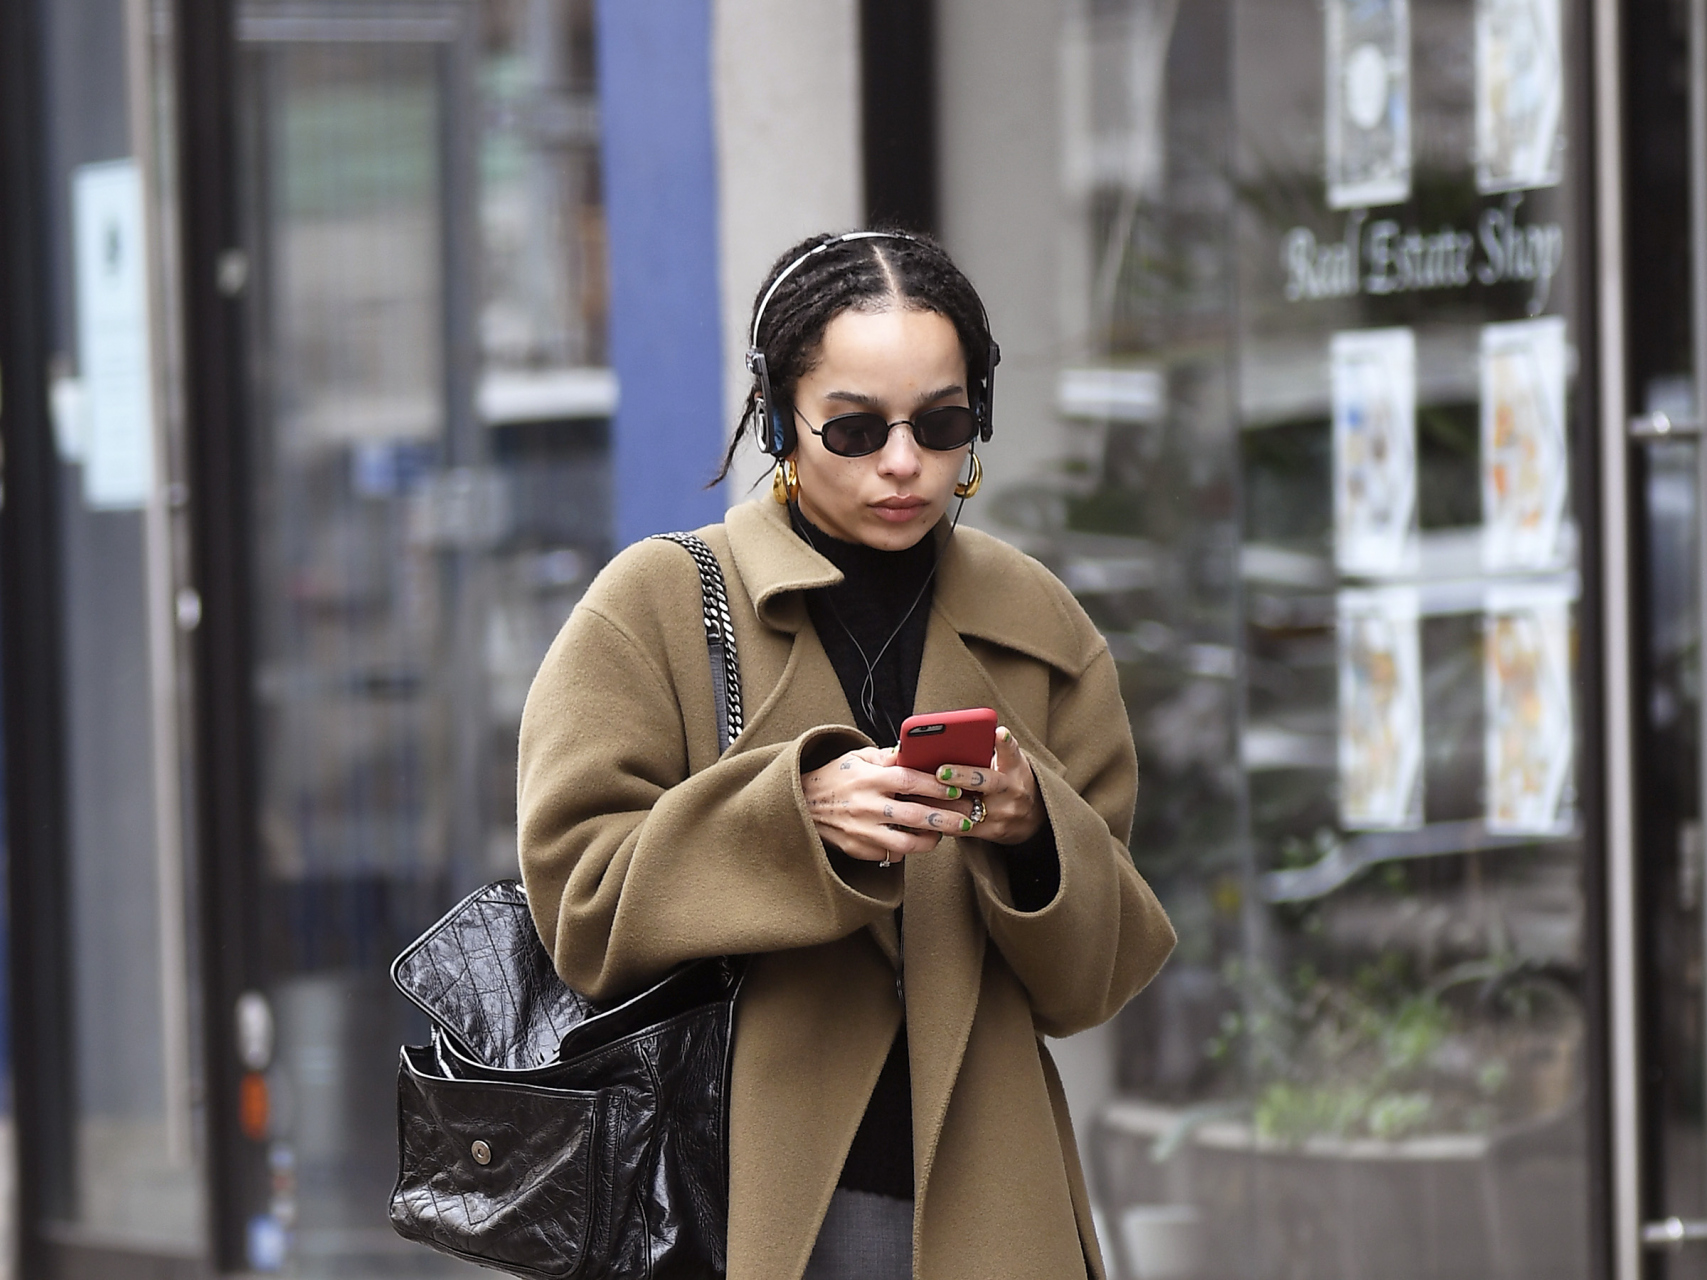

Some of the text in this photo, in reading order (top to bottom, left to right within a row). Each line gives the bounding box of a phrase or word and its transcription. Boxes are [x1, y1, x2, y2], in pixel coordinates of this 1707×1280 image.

[1284, 193, 1562, 316] Real Estate Shop
